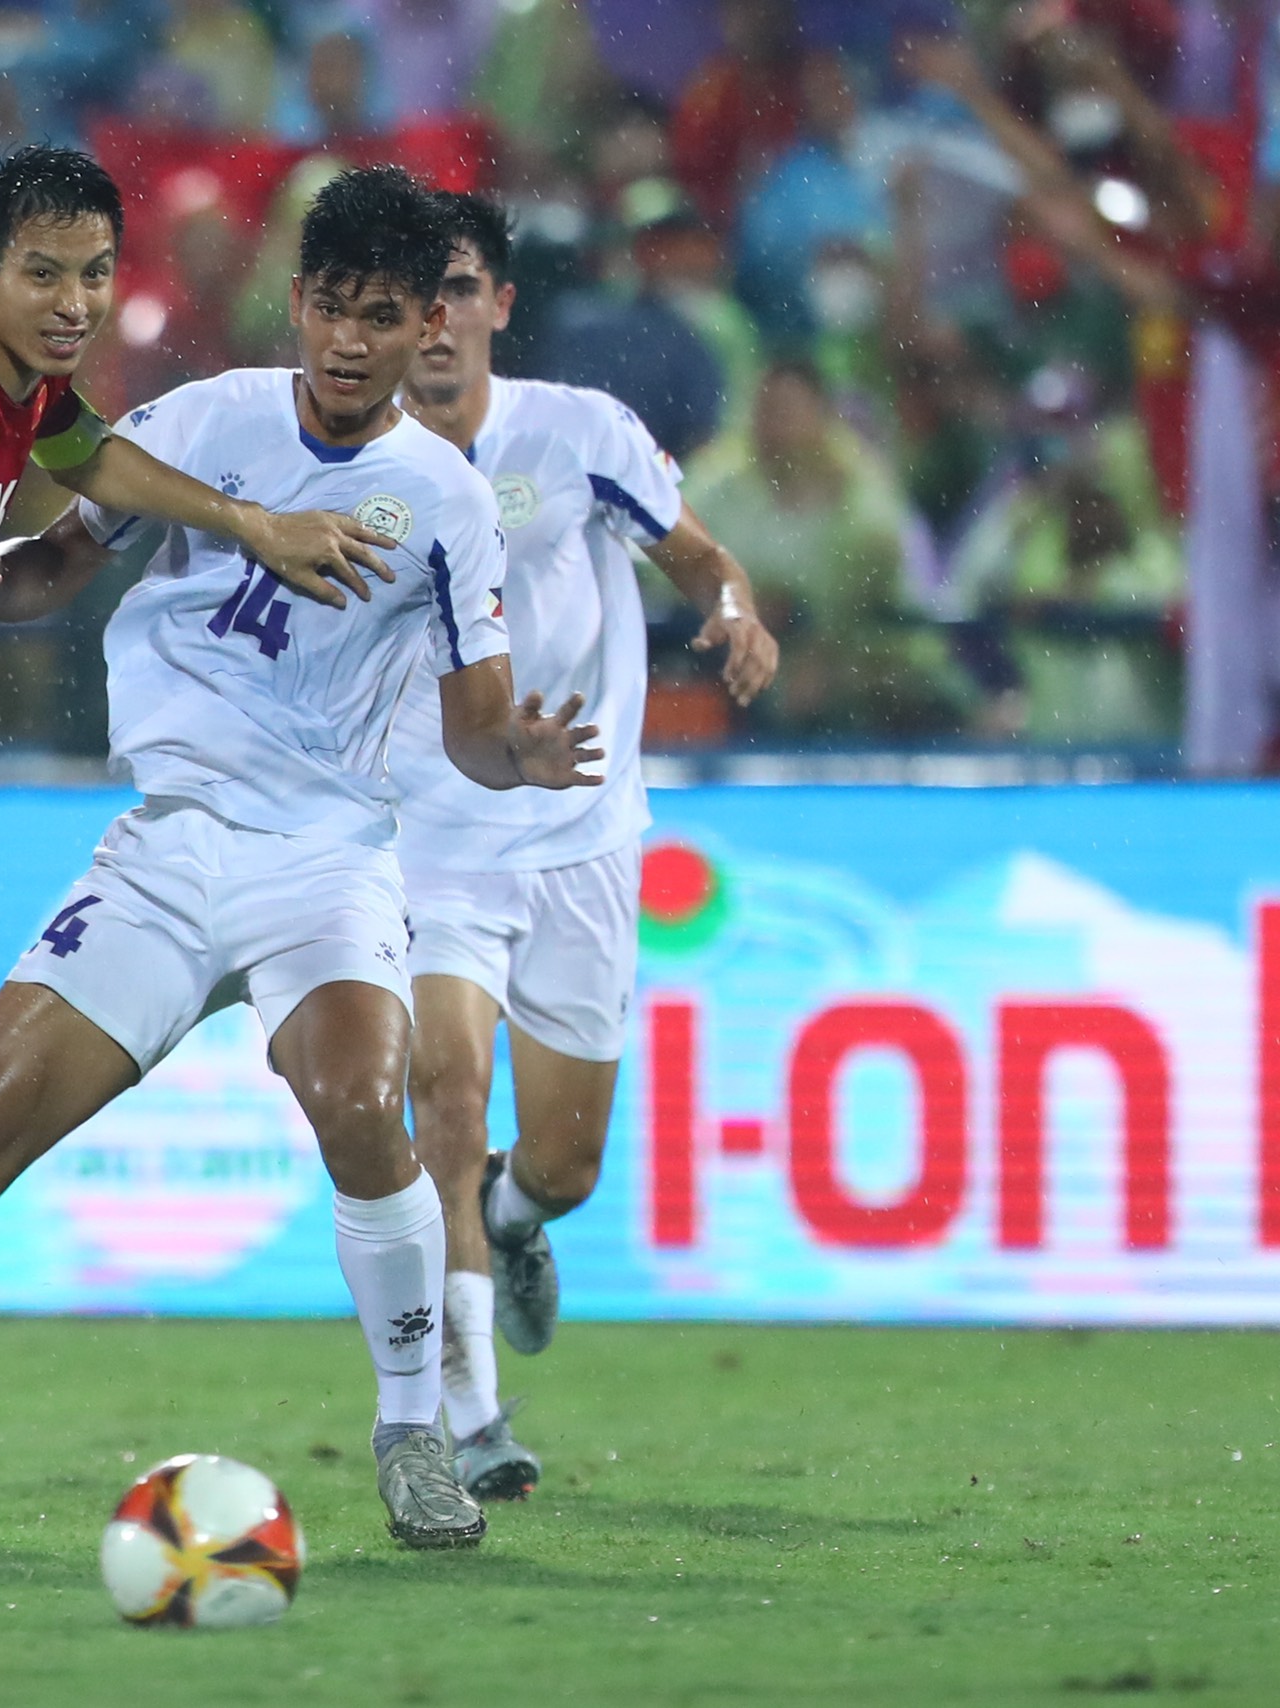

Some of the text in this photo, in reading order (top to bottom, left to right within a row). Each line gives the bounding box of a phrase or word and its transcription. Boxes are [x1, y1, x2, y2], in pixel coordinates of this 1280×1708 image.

[206, 557, 292, 662] 14
[28, 894, 104, 959] 4
[388, 1321, 435, 1346] KELM
